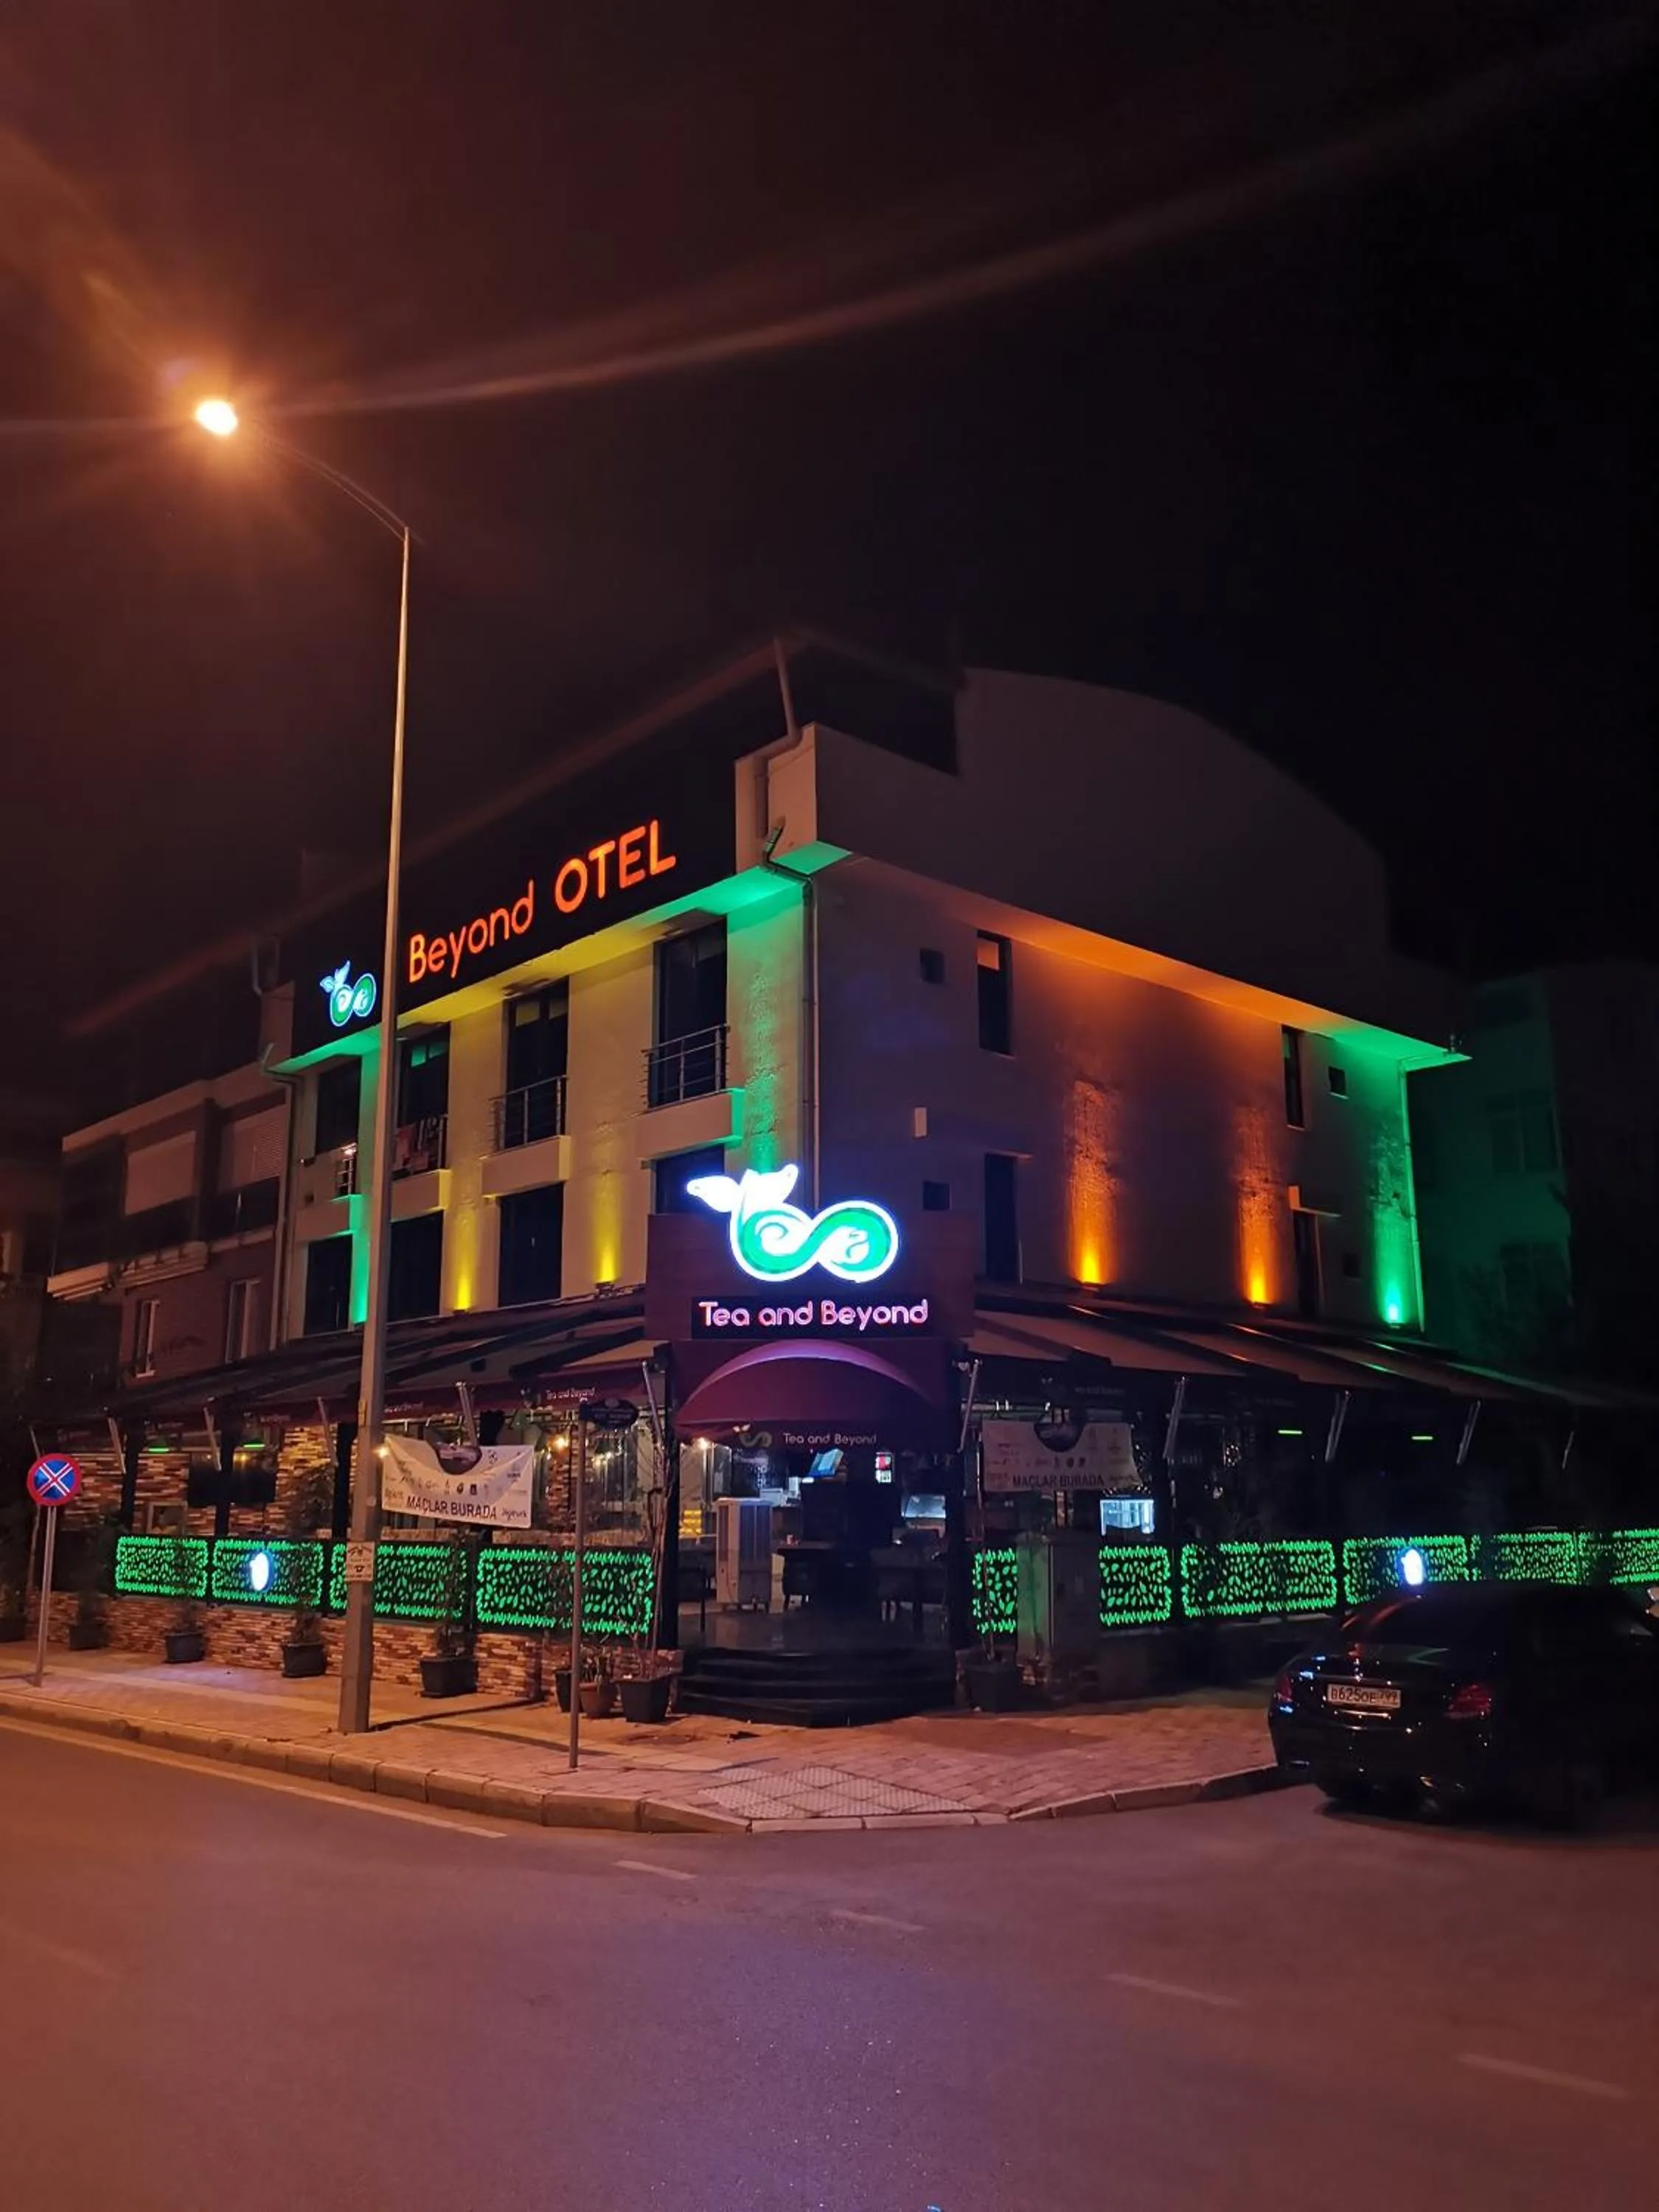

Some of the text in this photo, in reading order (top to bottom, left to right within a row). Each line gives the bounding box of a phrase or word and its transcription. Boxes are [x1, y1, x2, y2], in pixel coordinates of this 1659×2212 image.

[408, 819, 677, 984] Beyond OTEL
[698, 1299, 929, 1332] Tea and Beyond
[783, 1433, 877, 1447] Tea and Beyond
[406, 1495, 449, 1516] MAÇLAR
[451, 1502, 497, 1520] BURADA
